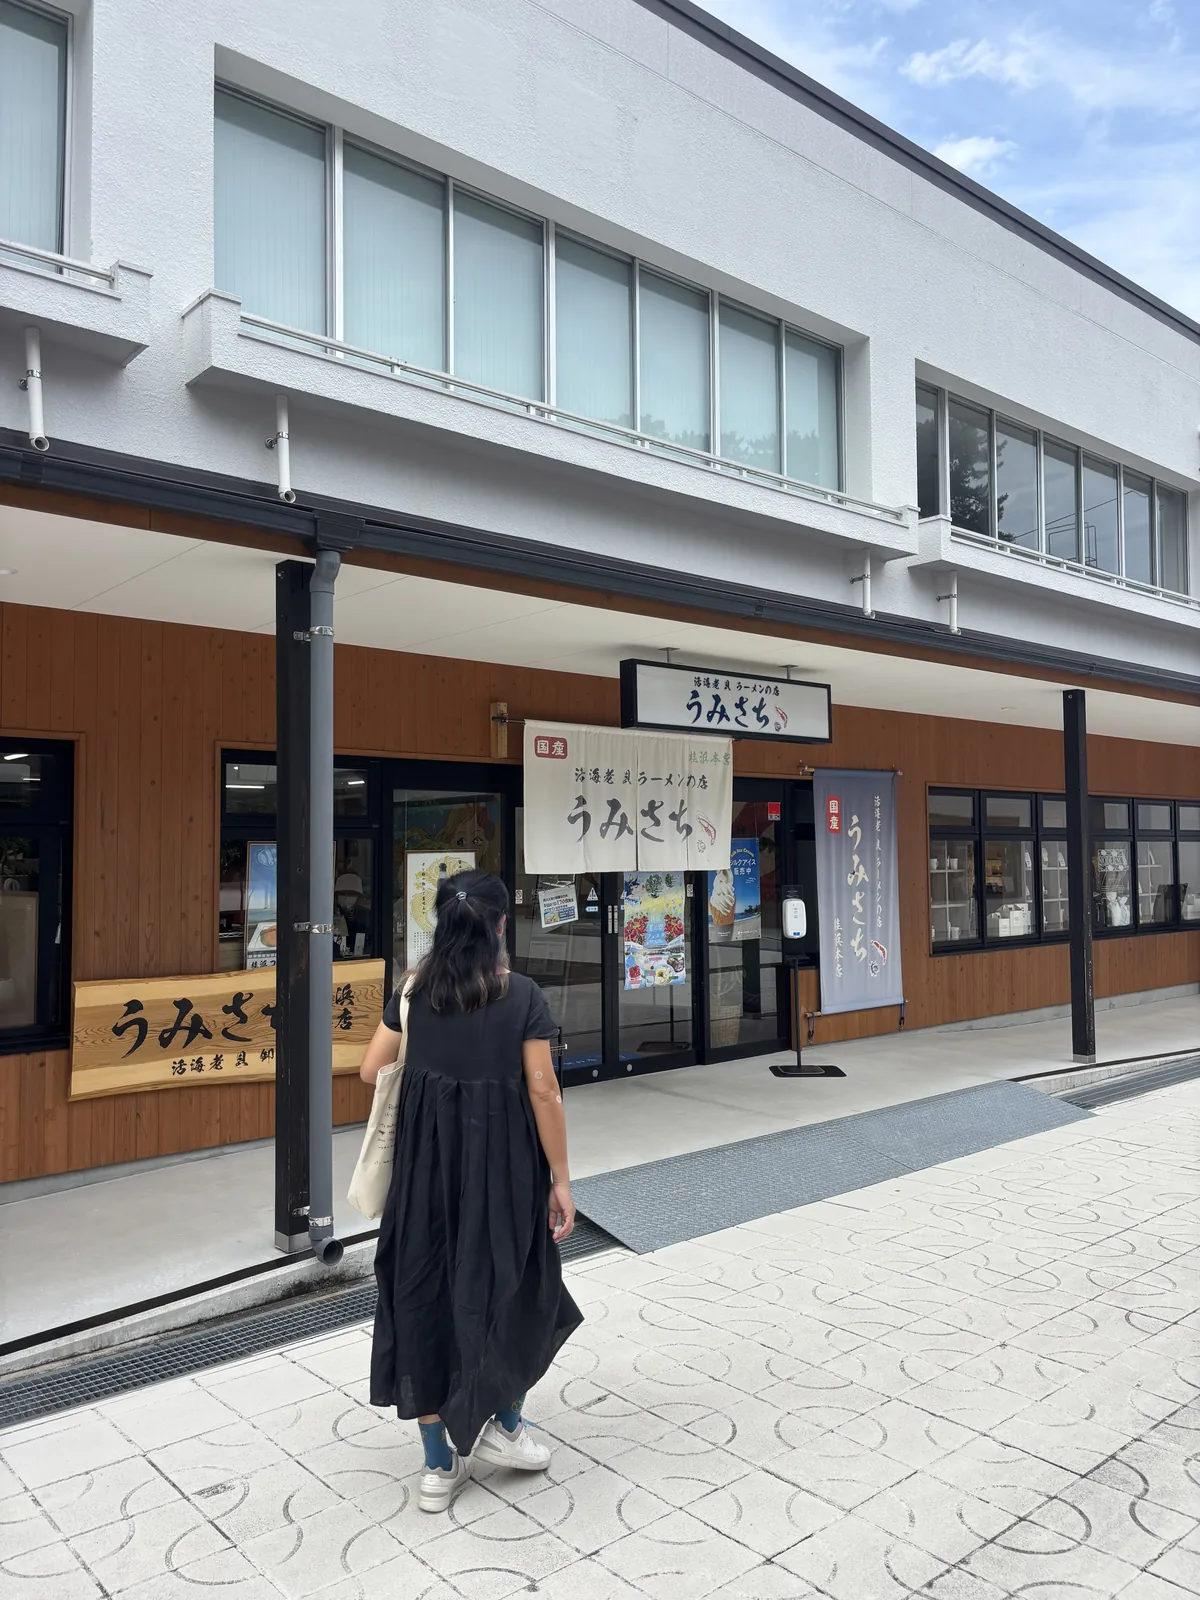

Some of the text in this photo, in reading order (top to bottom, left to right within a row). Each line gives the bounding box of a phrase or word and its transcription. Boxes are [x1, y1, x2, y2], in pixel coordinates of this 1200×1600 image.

[724, 680, 731, 691] 貝
[736, 682, 780, 697] ラーメンの店
[686, 689, 770, 730] うみさち
[536, 739, 566, 757] 国産
[637, 771, 709, 790] ラーメンの店
[567, 794, 693, 843] うみさち
[829, 799, 840, 830] 国産
[733, 867, 752, 876] 販売中
[847, 814, 869, 964] うみさち
[111, 991, 277, 1060] うみさ
[171, 1054, 224, 1076] 活海老
[235, 1050, 249, 1068] 貝
